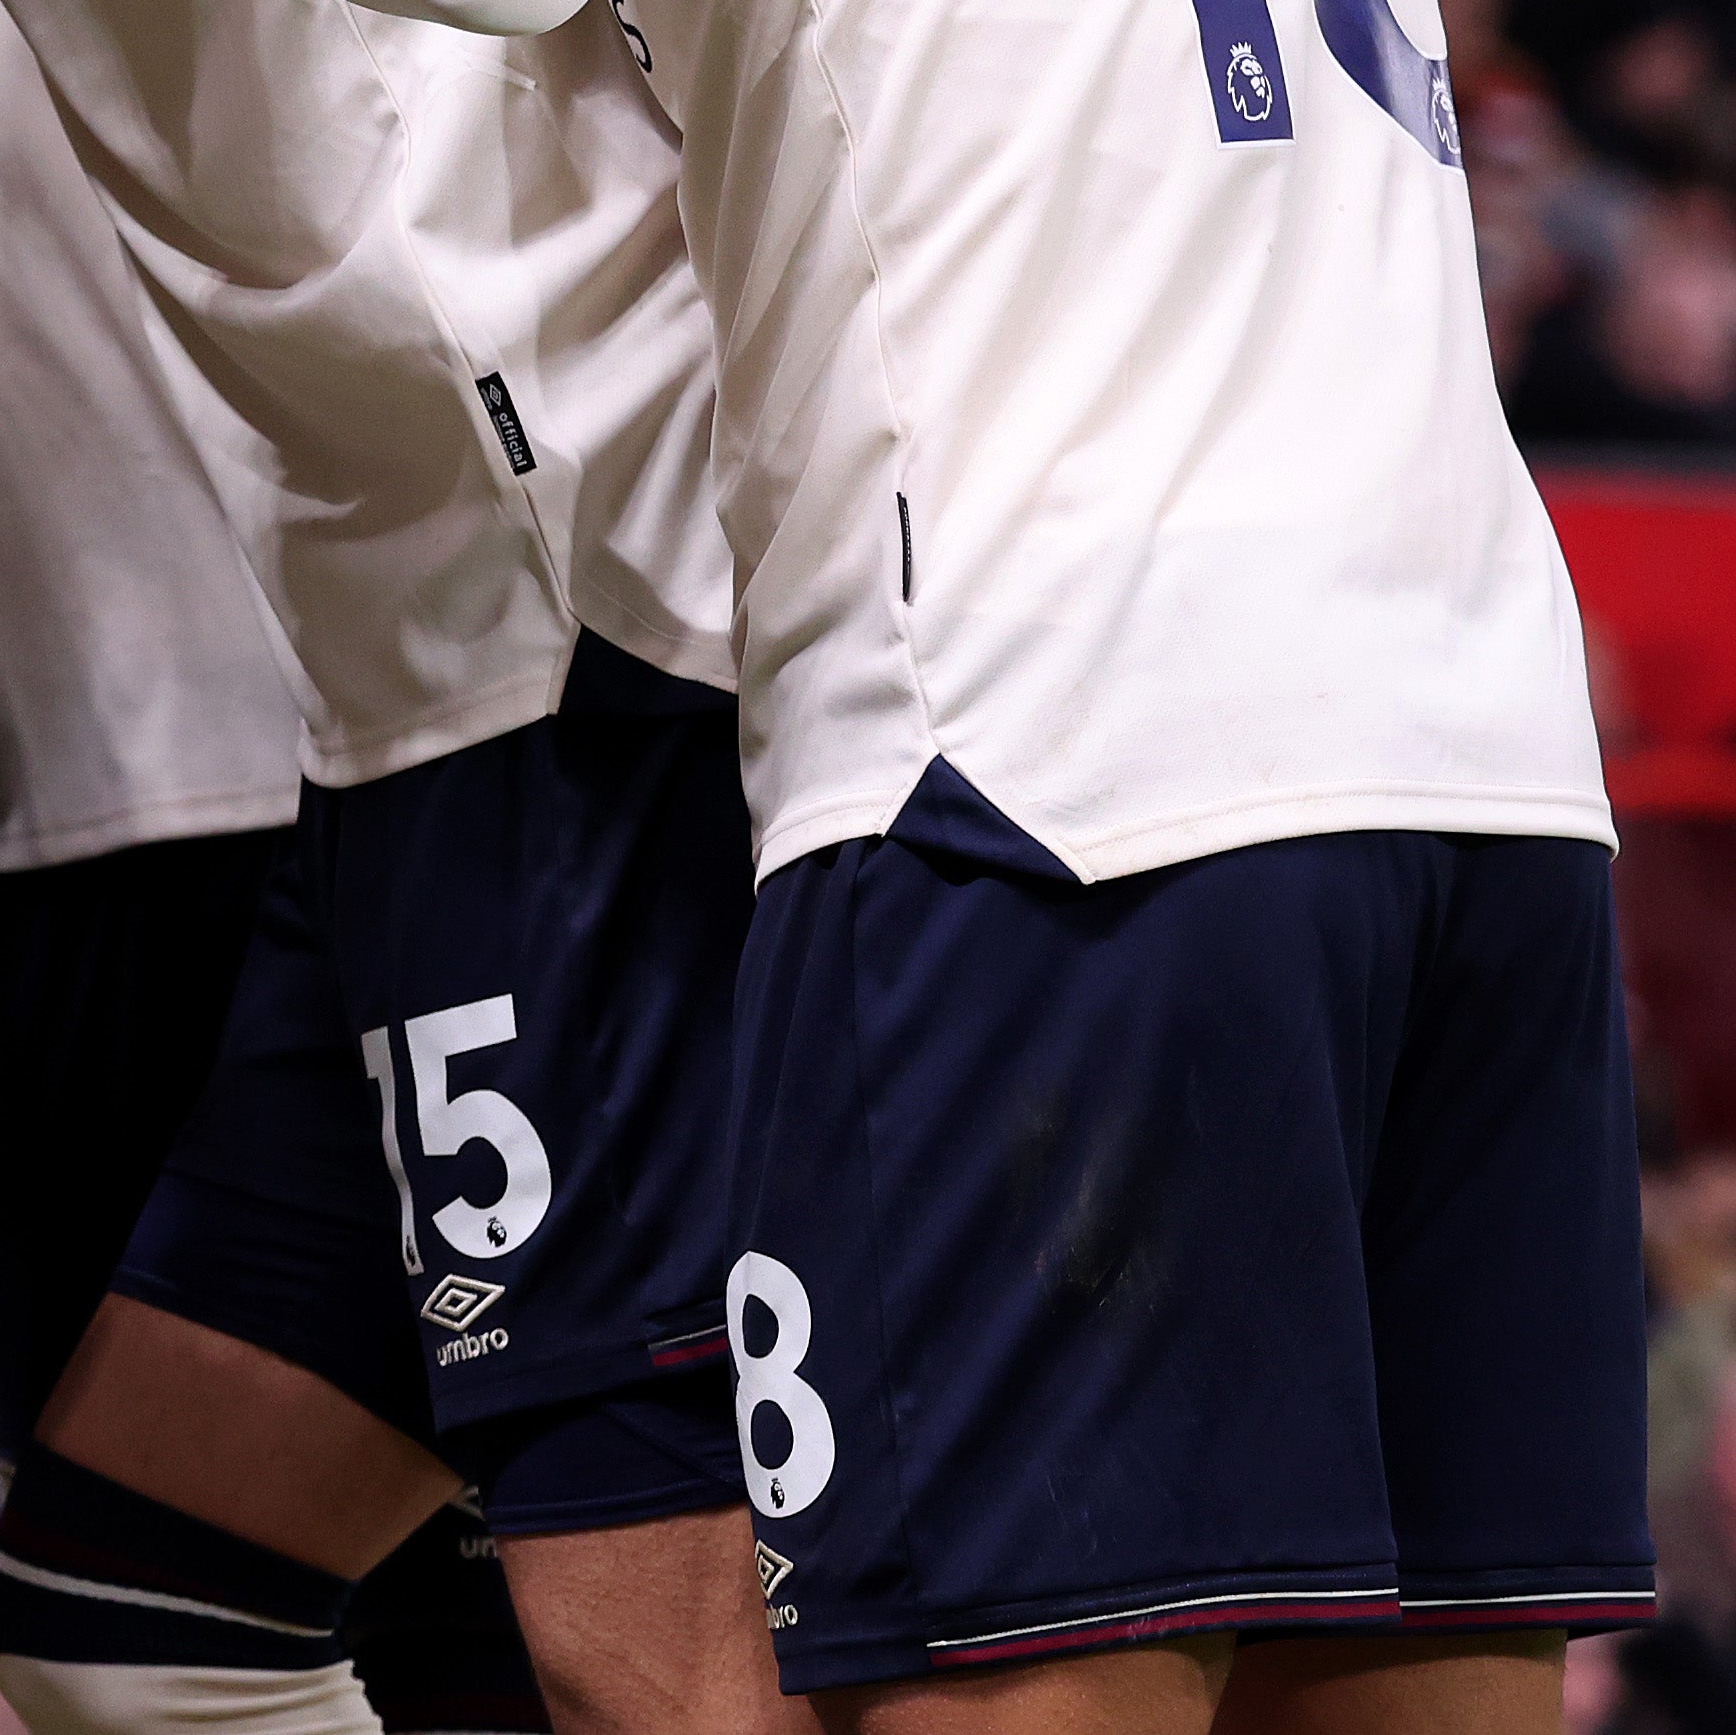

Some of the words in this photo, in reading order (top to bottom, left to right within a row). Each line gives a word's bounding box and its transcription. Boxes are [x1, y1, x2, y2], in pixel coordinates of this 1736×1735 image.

[498, 412, 528, 468] official
[361, 993, 552, 1276] 15
[435, 1325, 510, 1368] umbro
[726, 1250, 836, 1518] 8
